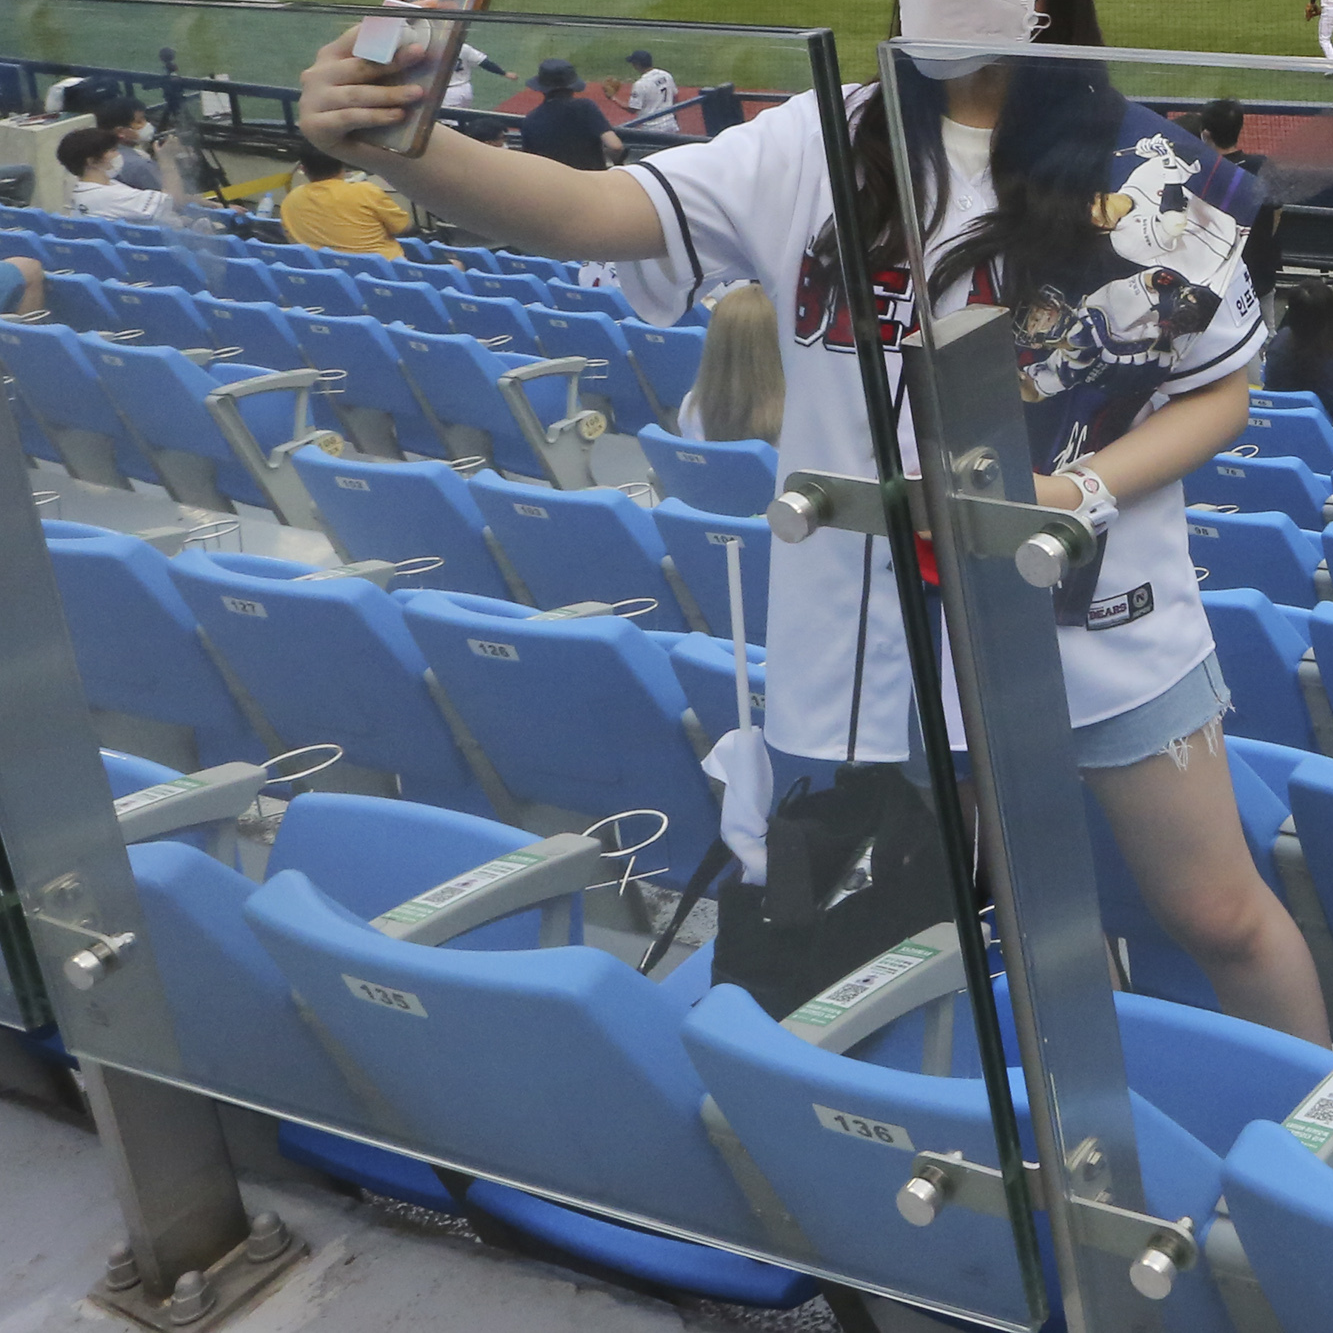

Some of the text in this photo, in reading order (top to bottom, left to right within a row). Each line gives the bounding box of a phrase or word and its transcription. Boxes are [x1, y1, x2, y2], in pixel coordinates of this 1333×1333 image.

[228, 601, 255, 614] 127
[1087, 601, 1128, 621] BEARS
[480, 645, 508, 658] 126
[360, 984, 411, 1011] 135
[829, 1112, 892, 1144] 136
